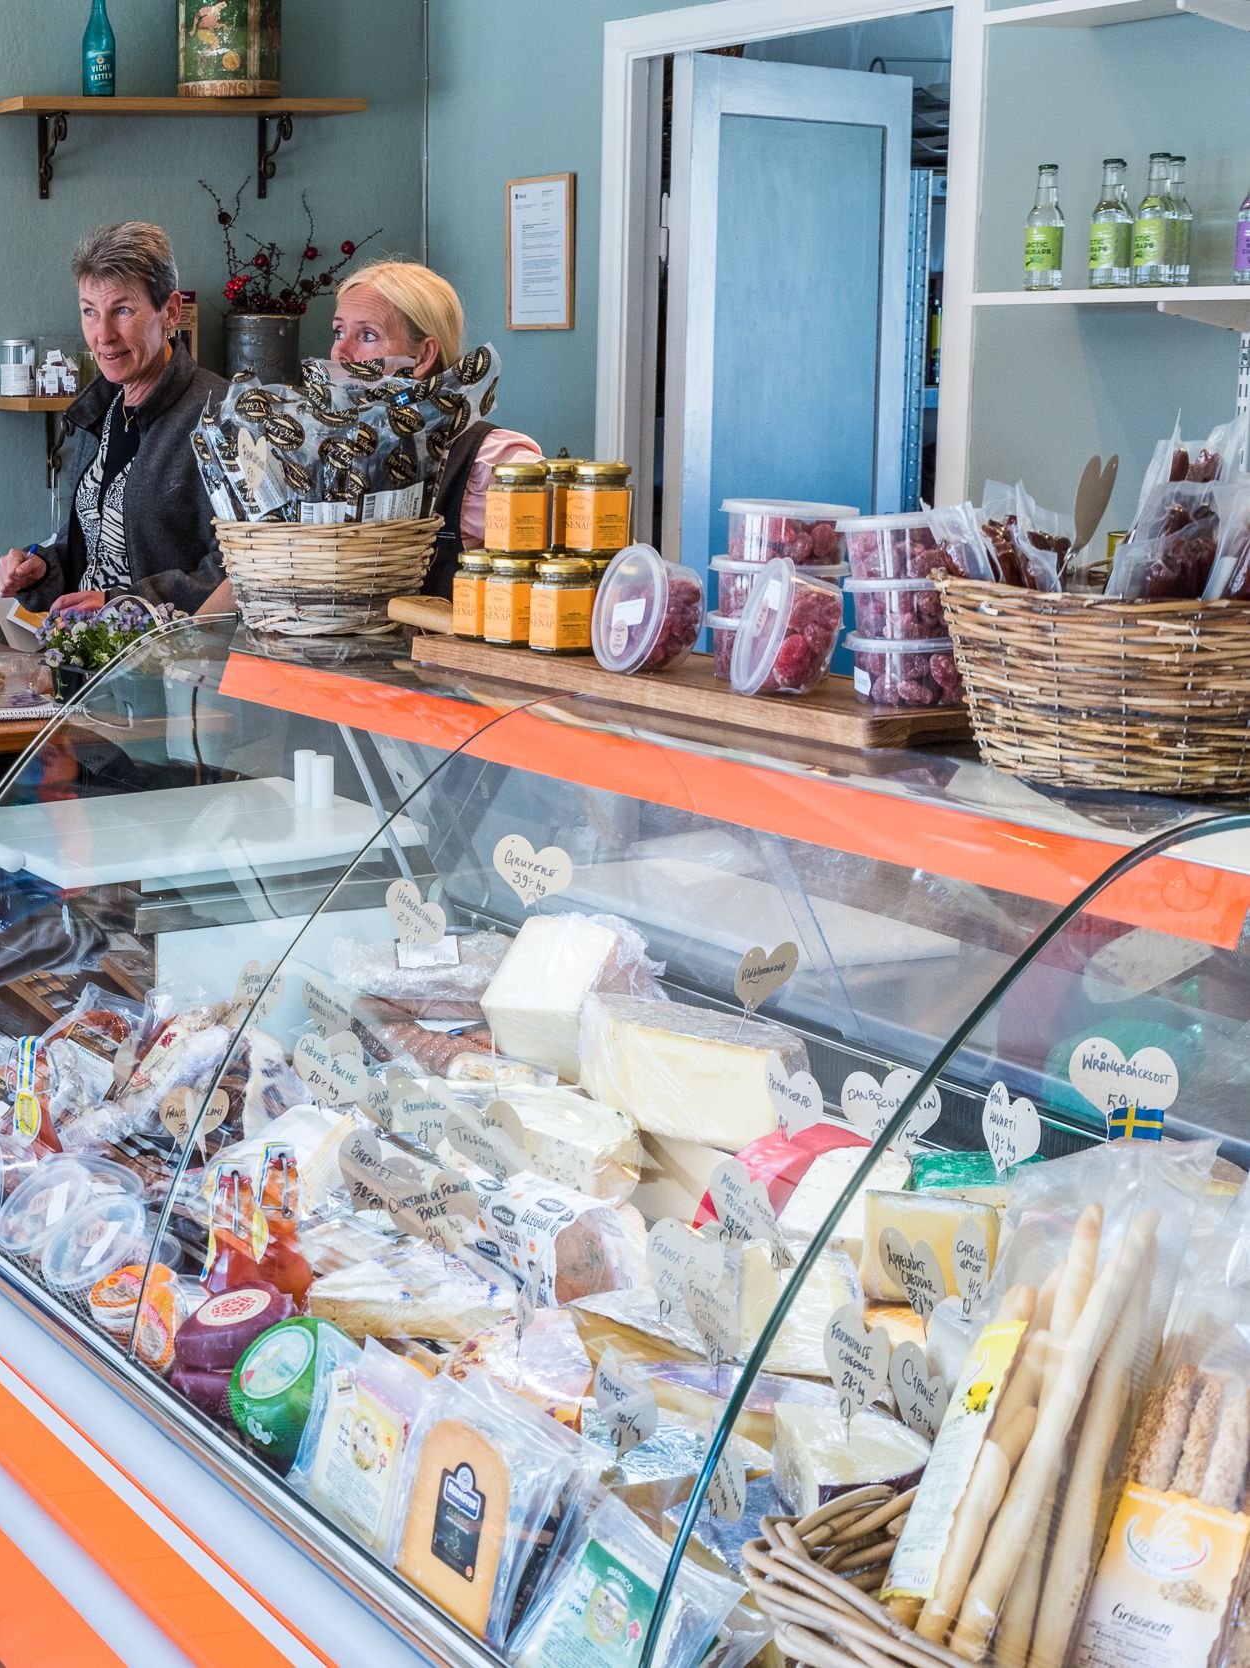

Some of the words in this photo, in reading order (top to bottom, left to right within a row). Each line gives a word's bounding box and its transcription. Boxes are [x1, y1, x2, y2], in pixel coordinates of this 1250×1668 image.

[91, 64, 111, 73] VICHY
[90, 73, 113, 82] VATTEN
[485, 521, 509, 530] SENAP
[566, 520, 592, 530] SENAP
[453, 607, 476, 617] SENAP
[484, 611, 511, 621] SENAP
[530, 618, 555, 627] SENAP
[504, 850, 559, 878] GRUYERE
[536, 881, 547, 896] hg
[328, 1080, 339, 1100] hg
[847, 1088, 883, 1102] DANBO
[989, 1110, 1017, 1132] HAVARTI
[1007, 1137, 1017, 1162] hg
[416, 1200, 449, 1224] BRIE
[857, 1380, 866, 1406] hg
